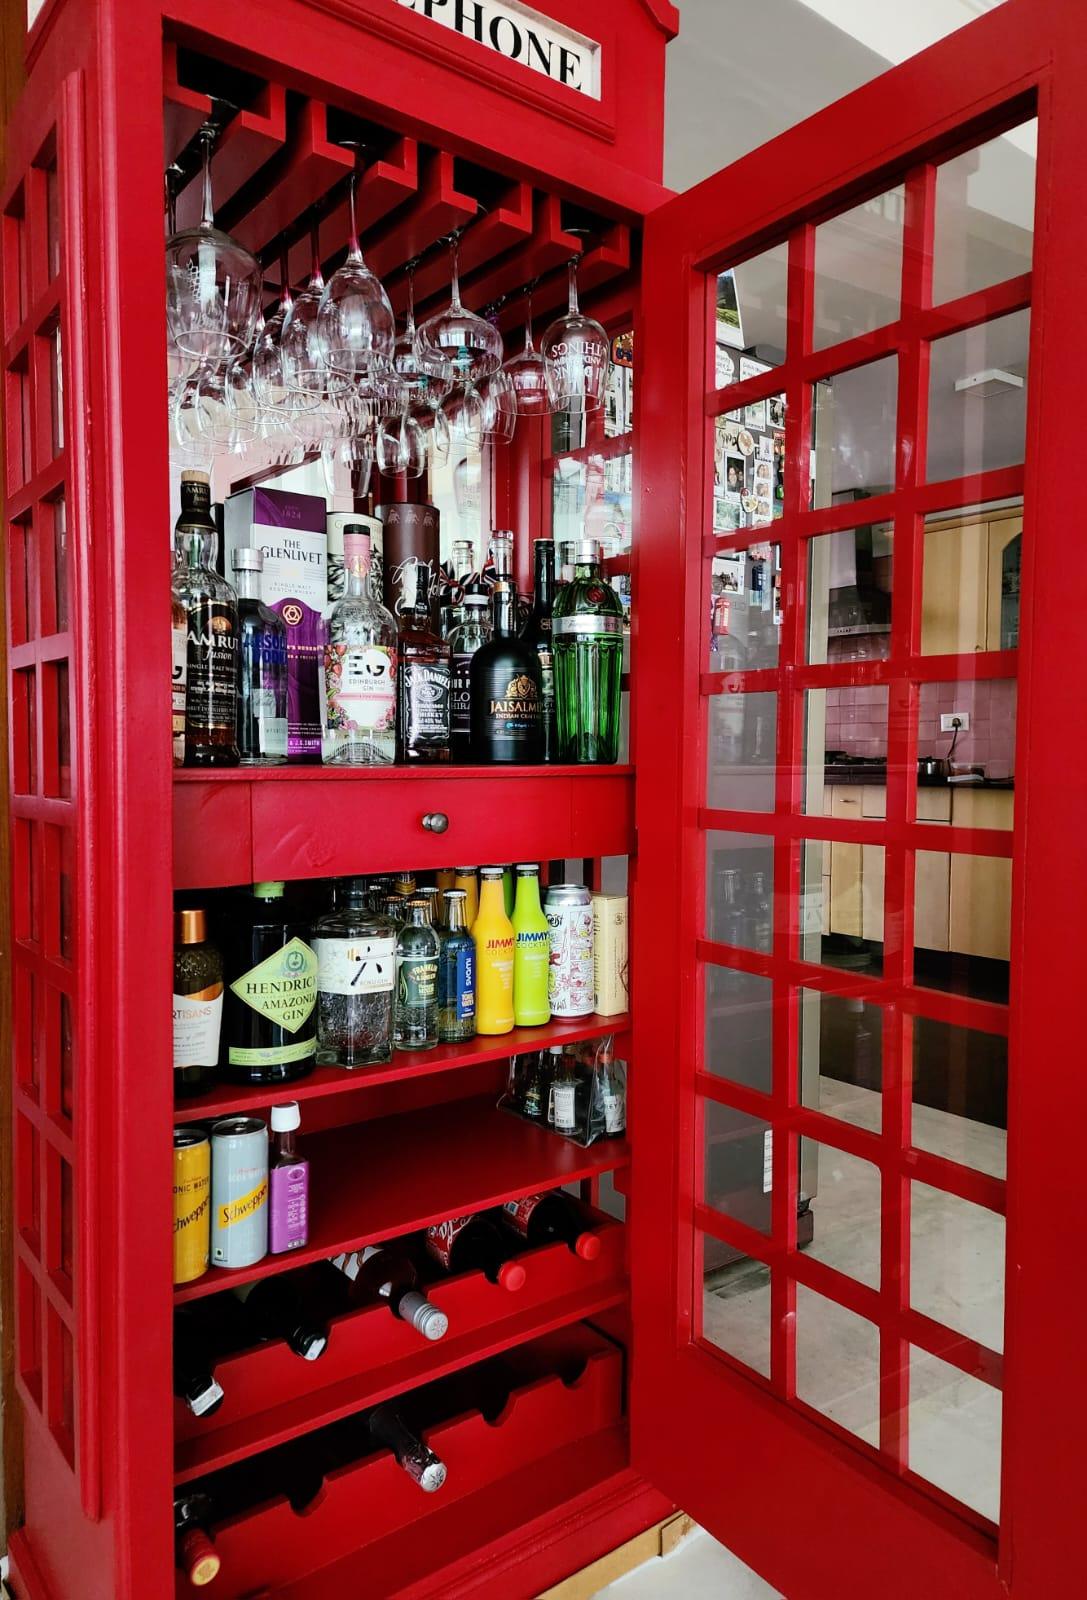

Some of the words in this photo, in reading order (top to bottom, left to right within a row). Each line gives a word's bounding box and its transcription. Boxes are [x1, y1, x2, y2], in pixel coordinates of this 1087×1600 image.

[397, 0, 582, 91] PHONE
[551, 341, 602, 357] THINGS
[553, 365, 593, 381] DNK
[186, 486, 209, 495] AMRU
[283, 538, 301, 549] THE
[260, 545, 323, 565] GLENLIVET
[202, 647, 232, 660] fusion
[246, 975, 316, 994] HENDRIC
[282, 1008, 305, 1021] GIN
